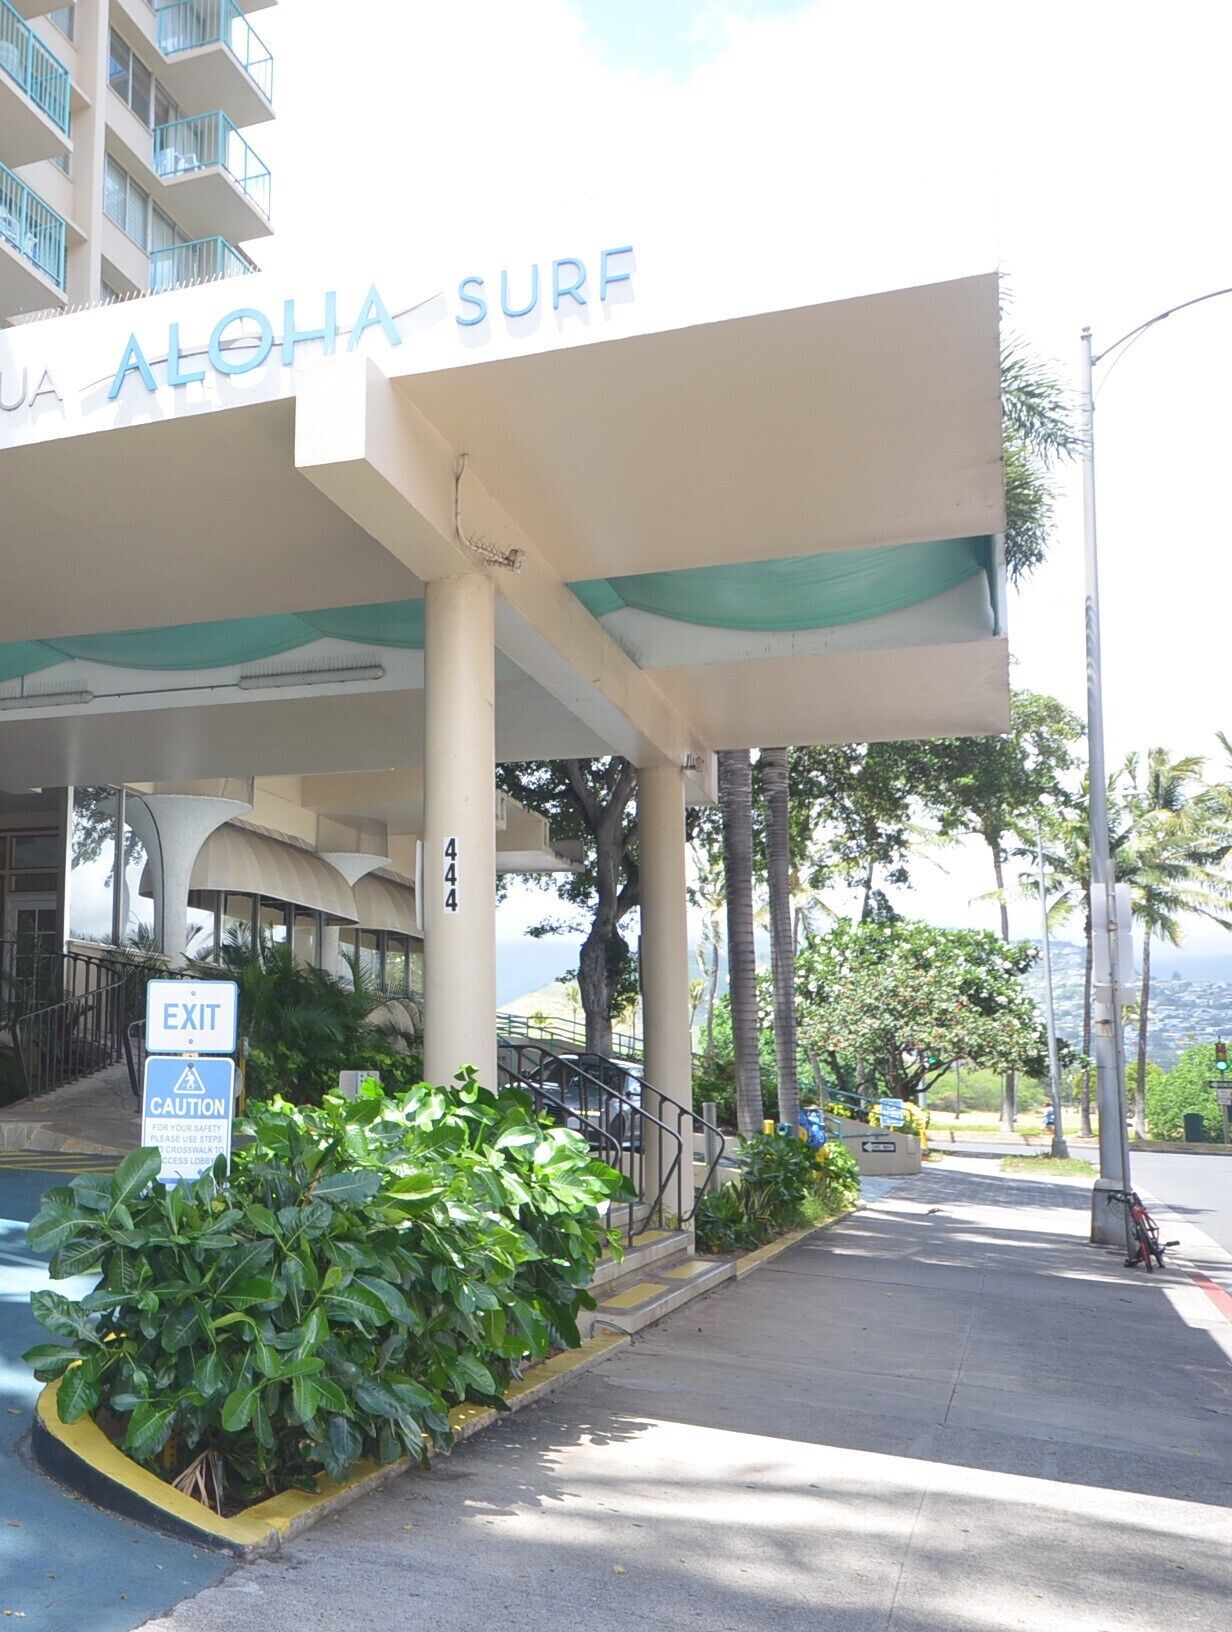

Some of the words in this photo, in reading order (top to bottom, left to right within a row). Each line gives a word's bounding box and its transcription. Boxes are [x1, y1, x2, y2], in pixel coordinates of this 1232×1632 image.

[107, 283, 403, 401] ALOHA
[455, 245, 634, 327] SURF
[444, 837, 458, 912] 444
[163, 1003, 221, 1031] EXIT
[150, 1096, 225, 1117] CAUTION
[152, 1123, 169, 1131] FOR
[171, 1124, 193, 1132] YOUR
[194, 1124, 222, 1133] SAFETY
[150, 1134, 181, 1143] PLEASE
[182, 1135, 198, 1143] USE
[199, 1135, 223, 1144] STEPS
[165, 1146, 213, 1154] CROSSWALK
[215, 1146, 225, 1154] TO
